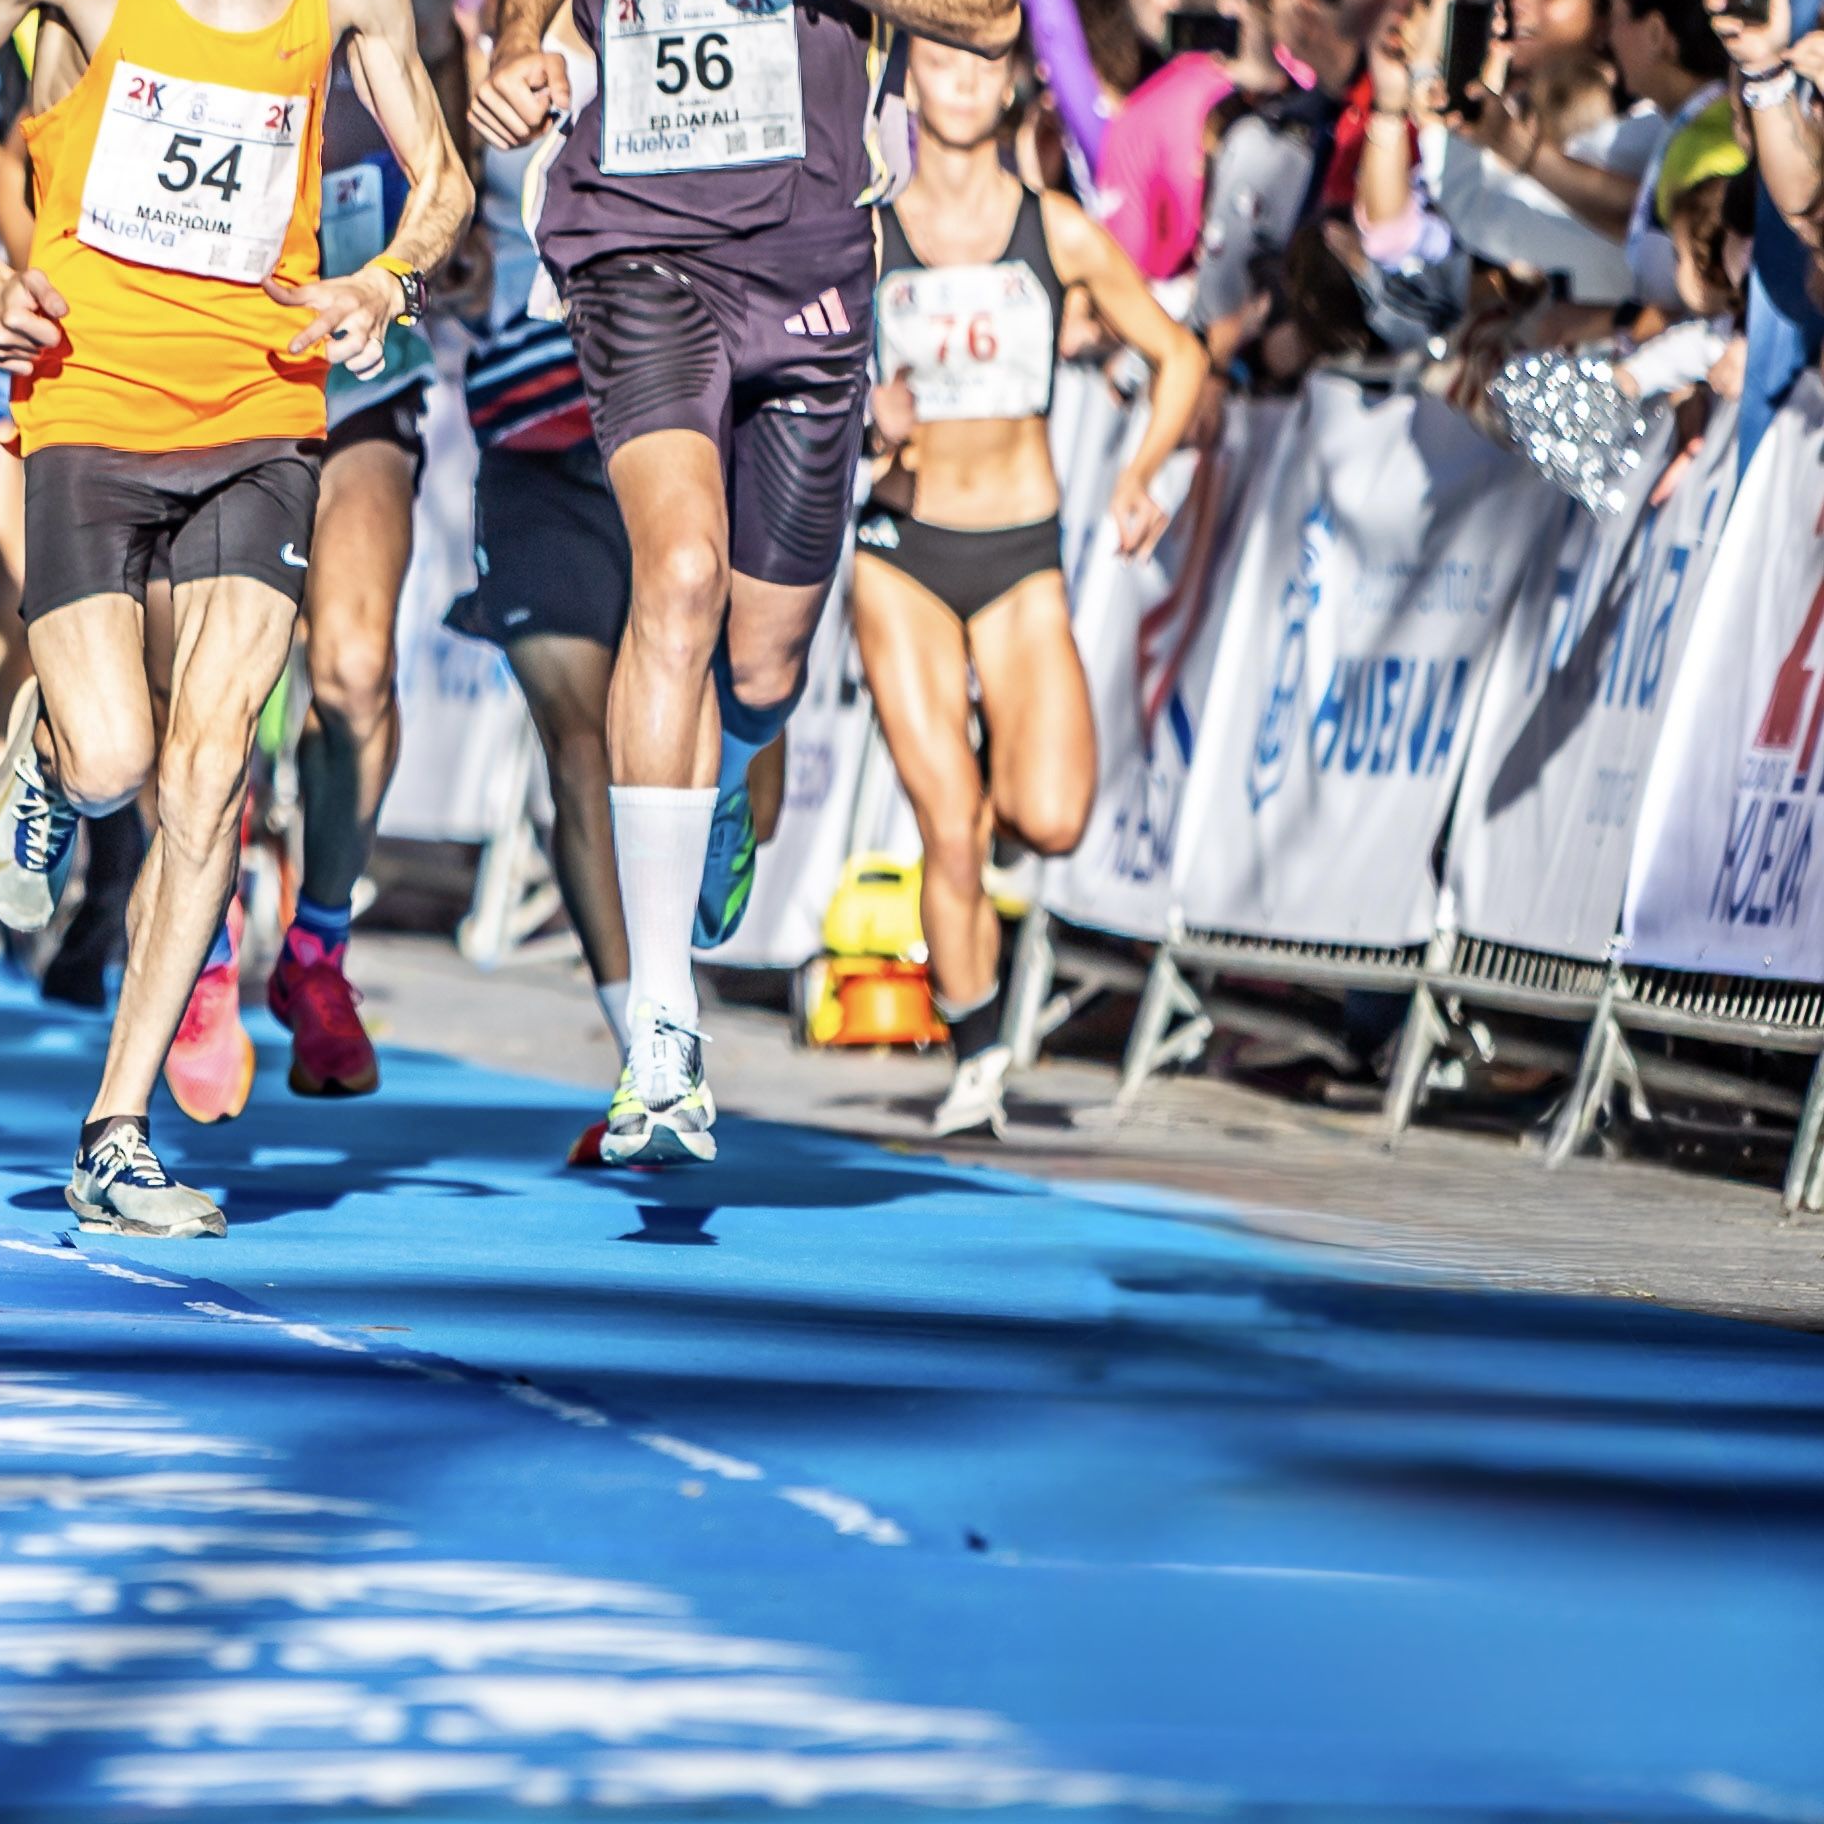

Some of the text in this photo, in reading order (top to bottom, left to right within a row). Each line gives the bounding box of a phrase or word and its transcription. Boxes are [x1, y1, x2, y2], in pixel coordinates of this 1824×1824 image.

[655, 32, 735, 95] 56
[157, 133, 243, 203] 54
[91, 206, 176, 249] Huelva
[136, 204, 233, 235] MARHOUM
[928, 309, 998, 364] 76
[1313, 656, 1469, 775] HUELVA
[1707, 795, 1814, 927] HUELVA
